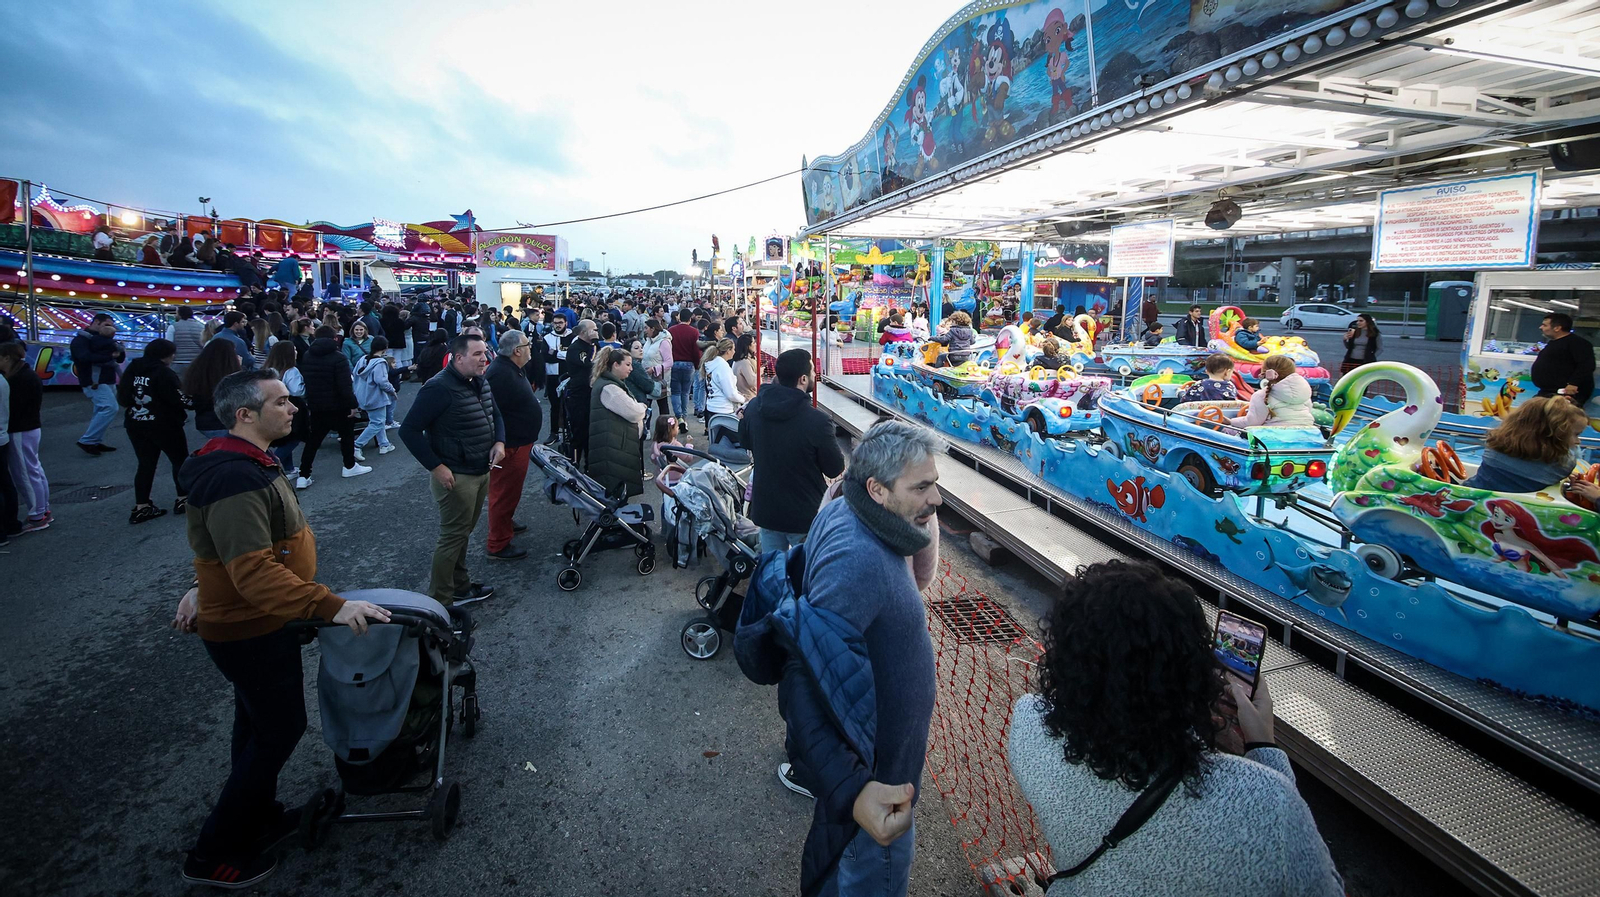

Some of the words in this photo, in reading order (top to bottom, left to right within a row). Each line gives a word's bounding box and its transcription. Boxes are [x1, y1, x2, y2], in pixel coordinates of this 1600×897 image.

[1436, 185, 1466, 195] AVISO
[525, 238, 553, 254] DULCE
[488, 260, 543, 269] VANESSA
